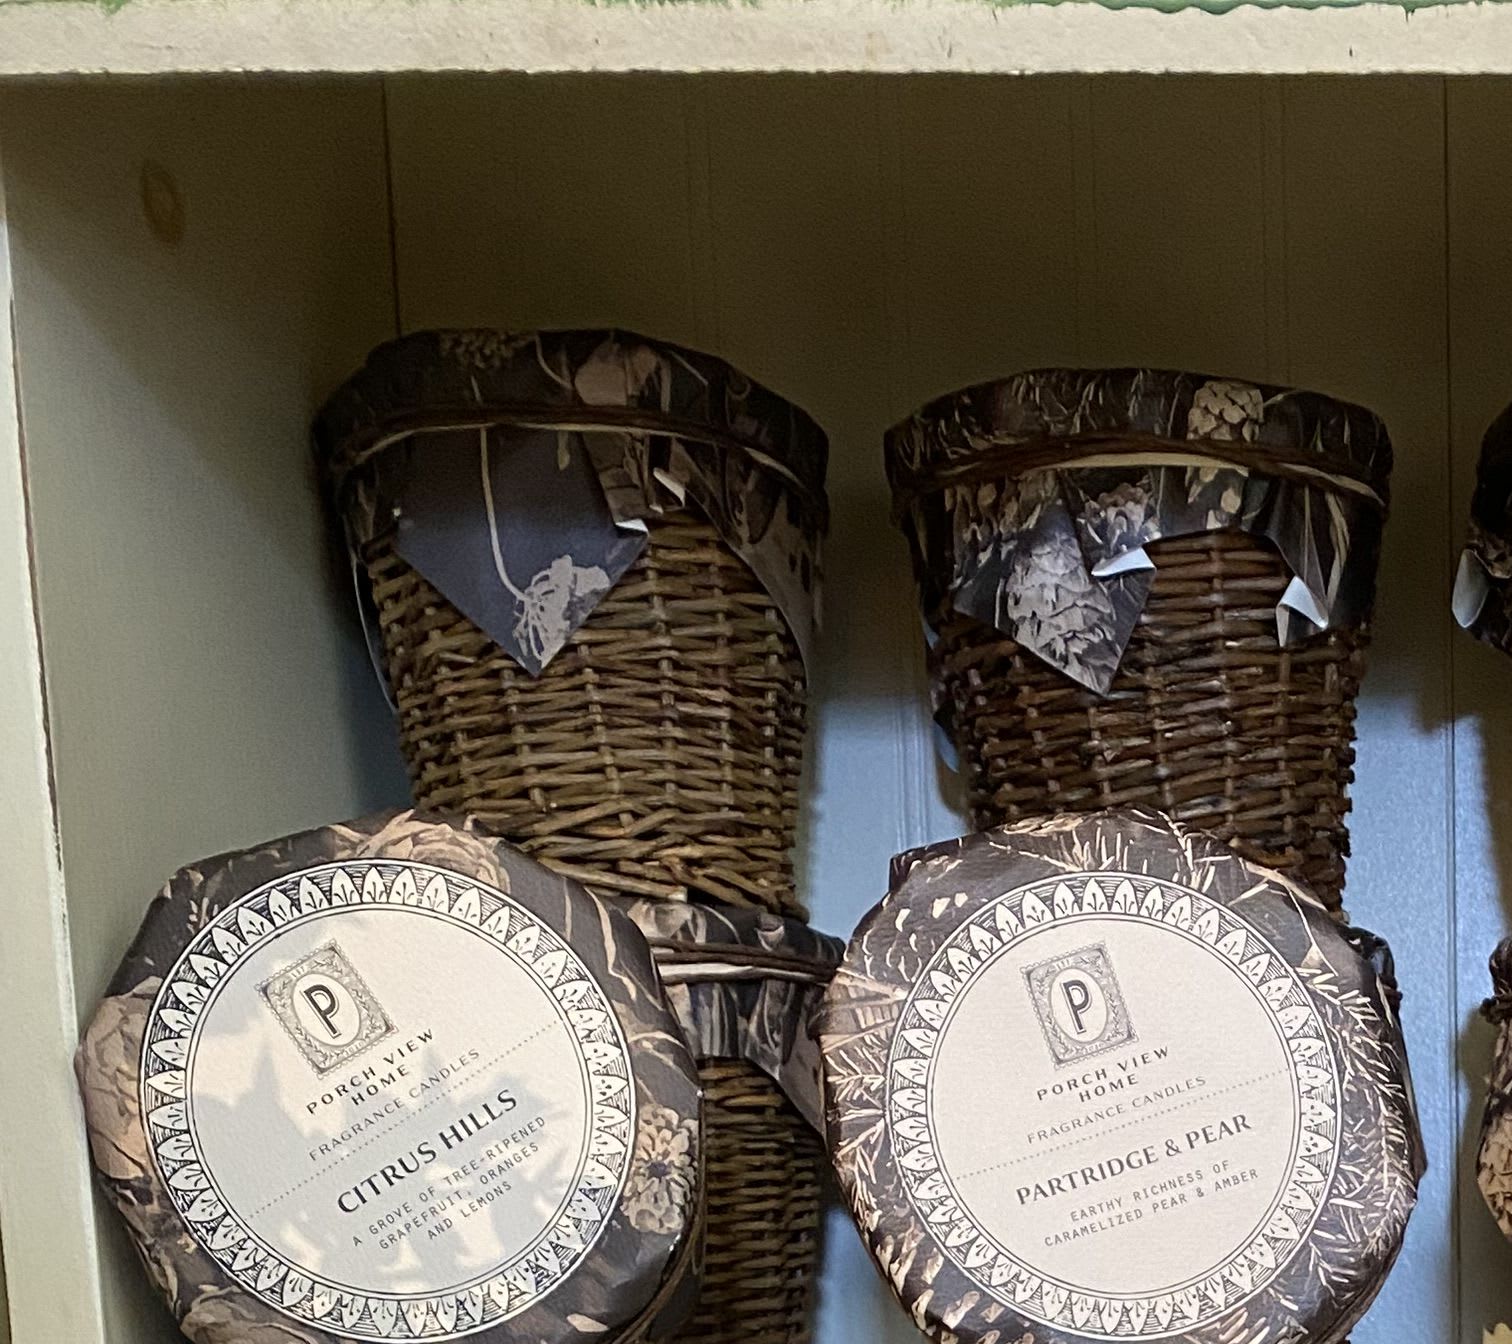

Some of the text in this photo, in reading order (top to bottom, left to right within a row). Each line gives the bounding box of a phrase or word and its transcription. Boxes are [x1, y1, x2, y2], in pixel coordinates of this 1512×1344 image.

[300, 984, 342, 1039] P
[1060, 979, 1094, 1034] P
[305, 1065, 377, 1115] PORCH
[382, 1028, 435, 1066] VIEW
[350, 1064, 410, 1107] HOME
[1036, 1067, 1108, 1101] PORCH
[1116, 1046, 1169, 1073] VIEW
[1078, 1073, 1139, 1103] HOME
[308, 1048, 480, 1162] FRAGRANCE CANDLES
[1027, 1075, 1207, 1145] FRAGRANCE CANDLES
[336, 1088, 518, 1215] CITRUS HILLS
[352, 1116, 546, 1247] A GROVE OF TREE-RIPENED
[478, 1141, 540, 1186] ORANGES
[1016, 1113, 1252, 1206] PARTRIDGE & PEAR
[426, 1180, 513, 1241] AND LEMONS
[1044, 1168, 1259, 1247] CARAMELIZED PEAR & AMBER
[1070, 1159, 1230, 1223] EARTHY RICHNESS OF
